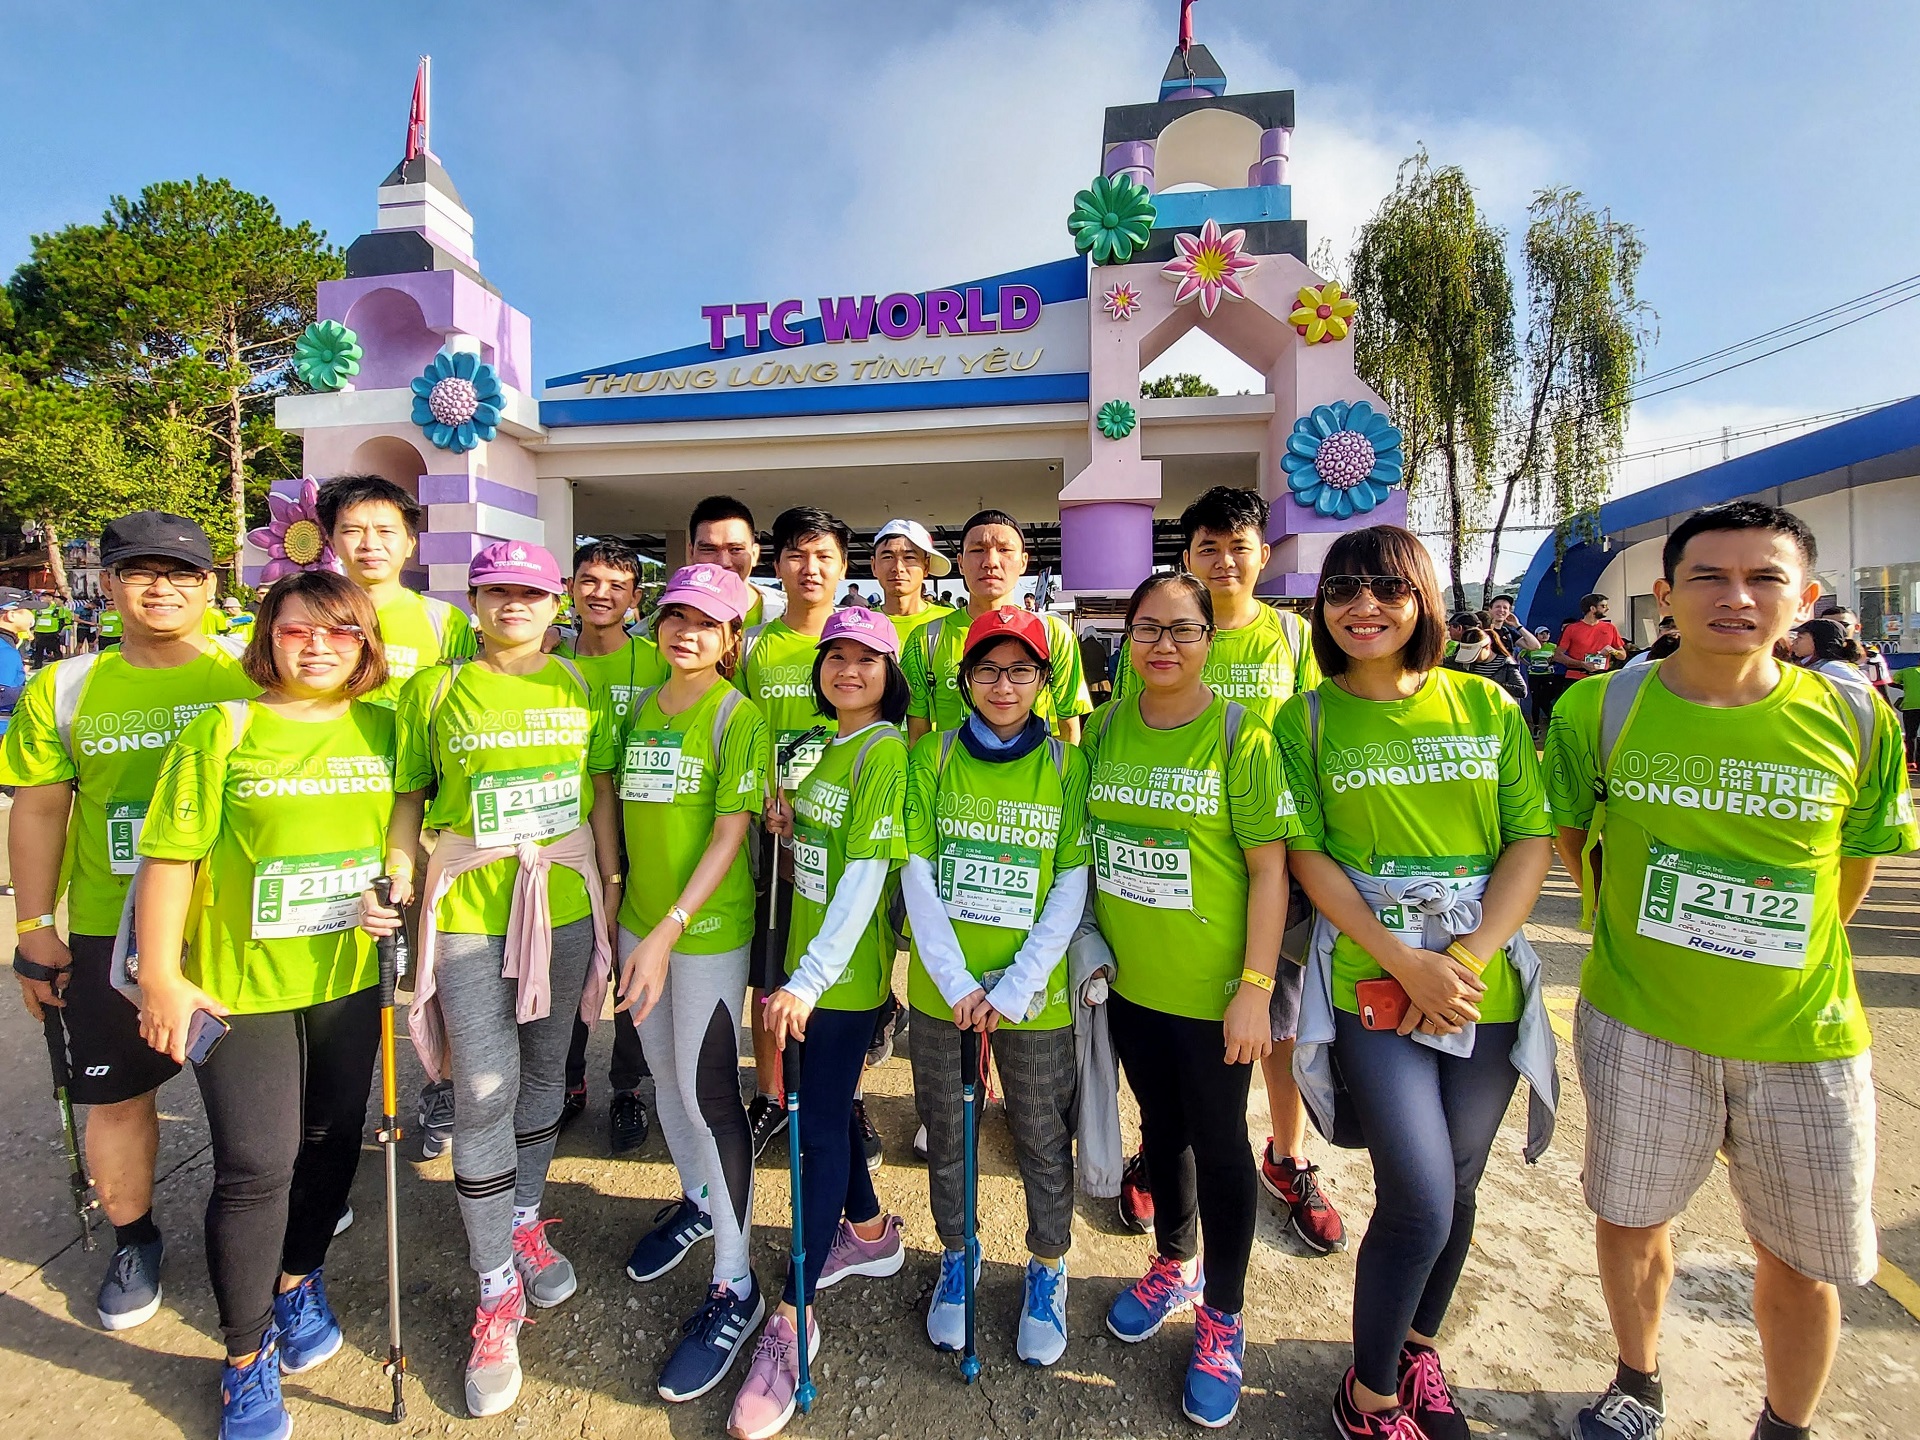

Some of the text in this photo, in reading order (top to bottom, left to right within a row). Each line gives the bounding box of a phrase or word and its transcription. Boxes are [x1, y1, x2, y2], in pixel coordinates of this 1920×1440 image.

[702, 284, 1043, 351] TTC WORLD
[581, 370, 718, 395] THUNG
[727, 360, 838, 388] LŨNG
[958, 347, 1044, 374] YÊU
[1250, 669, 1290, 683] TRUE
[76, 708, 170, 739] 2020
[548, 714, 588, 728] TRUE
[448, 730, 588, 753] CONQUERORS
[1413, 744, 1439, 753] FOR
[1416, 742, 1500, 762] THE TRUE
[628, 750, 671, 767] 21130
[1326, 740, 1412, 775] 2020
[1148, 775, 1220, 796] THE TRUE
[1149, 773, 1169, 781] FOR
[1332, 761, 1498, 793] CONQUERORS
[1719, 767, 1754, 780] FOR
[1719, 771, 1837, 800] THE TRUE
[510, 782, 572, 807] 21110
[1610, 777, 1834, 822] CONQUERORS
[480, 794, 495, 830] 21 km
[997, 806, 1017, 816] FOR
[997, 809, 1061, 831] THE TRUE
[115, 823, 130, 859] 21 km
[514, 827, 555, 841] Revive
[936, 817, 1057, 849] CONQUERORS
[1099, 841, 1107, 875] 21 km
[1116, 846, 1179, 870] 21109
[299, 869, 369, 896] 21111
[942, 862, 952, 897] 21 km
[964, 864, 1029, 889] 21125
[1696, 870, 1746, 884] CONQUERORS
[261, 881, 279, 919] 21 km
[1120, 889, 1157, 904] Revive
[1650, 875, 1673, 919] 21 km
[1694, 883, 1799, 920] 21122
[297, 920, 347, 934] Revive
[960, 910, 1001, 923] Revive
[1700, 920, 1726, 929] SUUNTO
[1687, 937, 1757, 959] Revive
